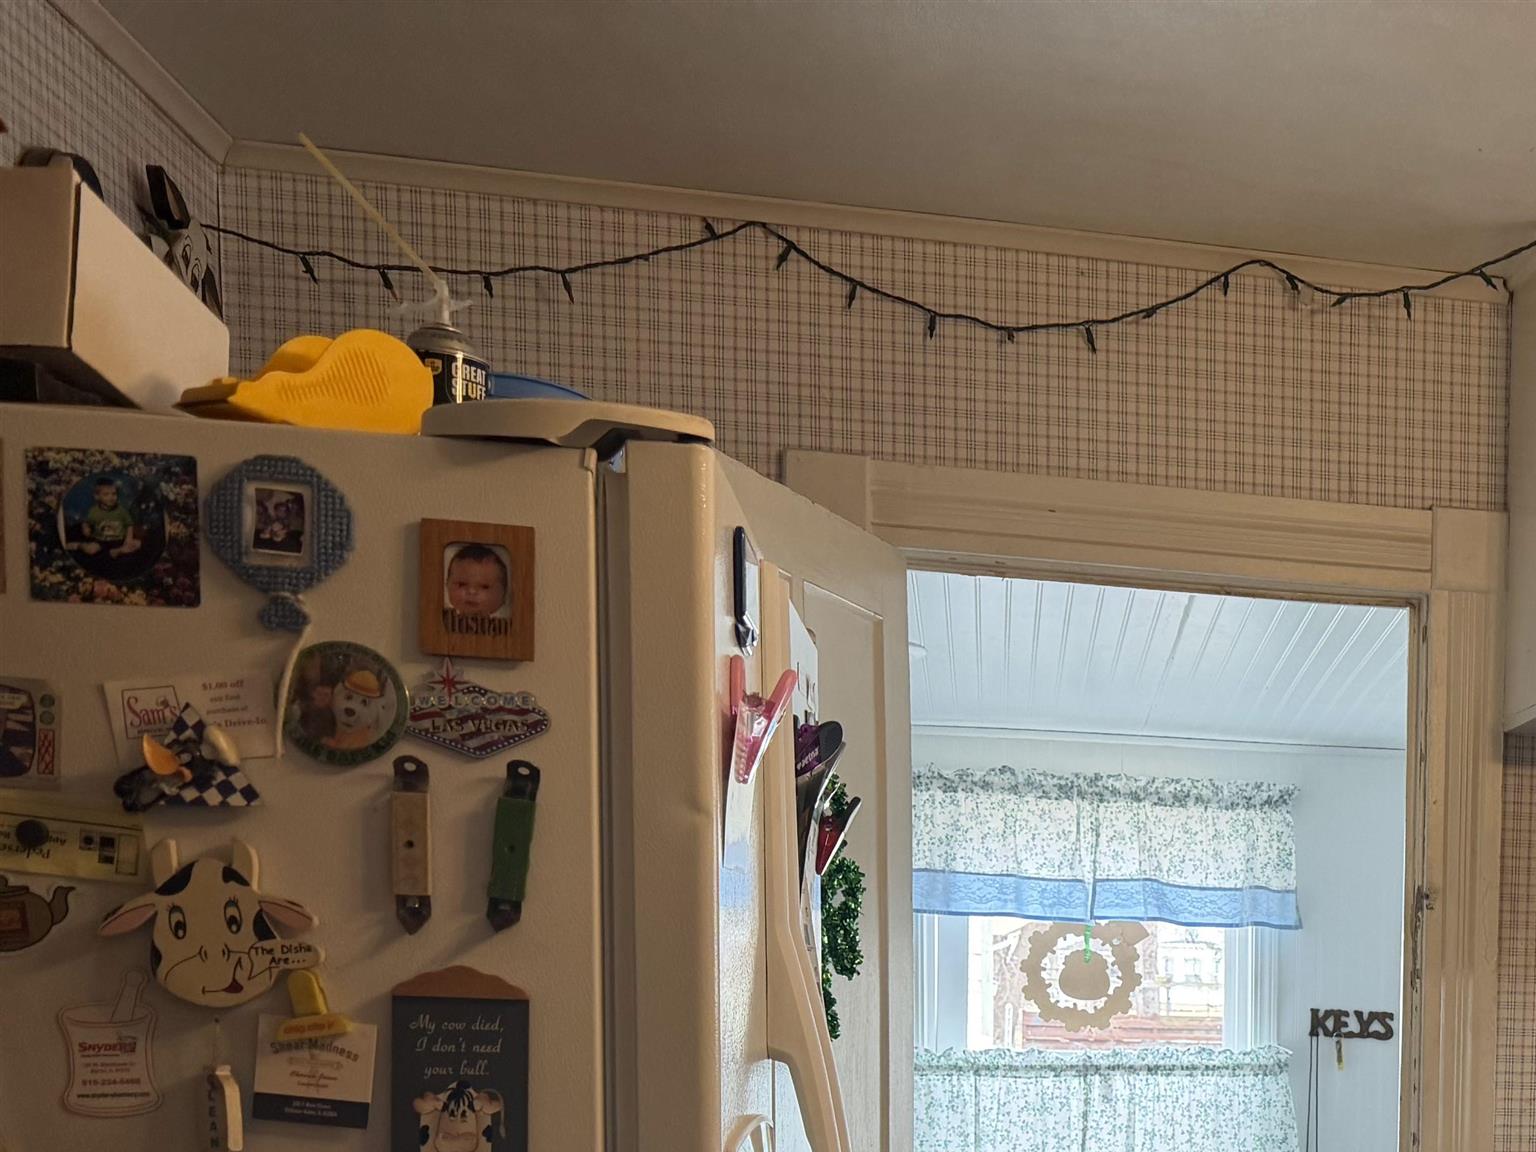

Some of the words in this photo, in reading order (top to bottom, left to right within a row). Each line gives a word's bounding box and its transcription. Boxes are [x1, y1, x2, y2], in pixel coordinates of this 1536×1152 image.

[452, 362, 486, 386] GREAT
[452, 378, 486, 400] STUFF
[420, 695, 531, 707] WELCOME
[430, 719, 464, 733] LAS
[471, 718, 529, 733] VEGAS
[252, 945, 274, 956] The
[408, 1014, 435, 1034] My
[441, 1021, 467, 1031] cow
[471, 1015, 505, 1033] died,
[1309, 1007, 1394, 1041] KEYS
[308, 1037, 360, 1063] Madness
[415, 1036, 427, 1052] I
[432, 1037, 466, 1053] don't
[472, 1038, 502, 1053] need
[423, 1065, 454, 1079] your
[459, 1059, 490, 1076] bull.
